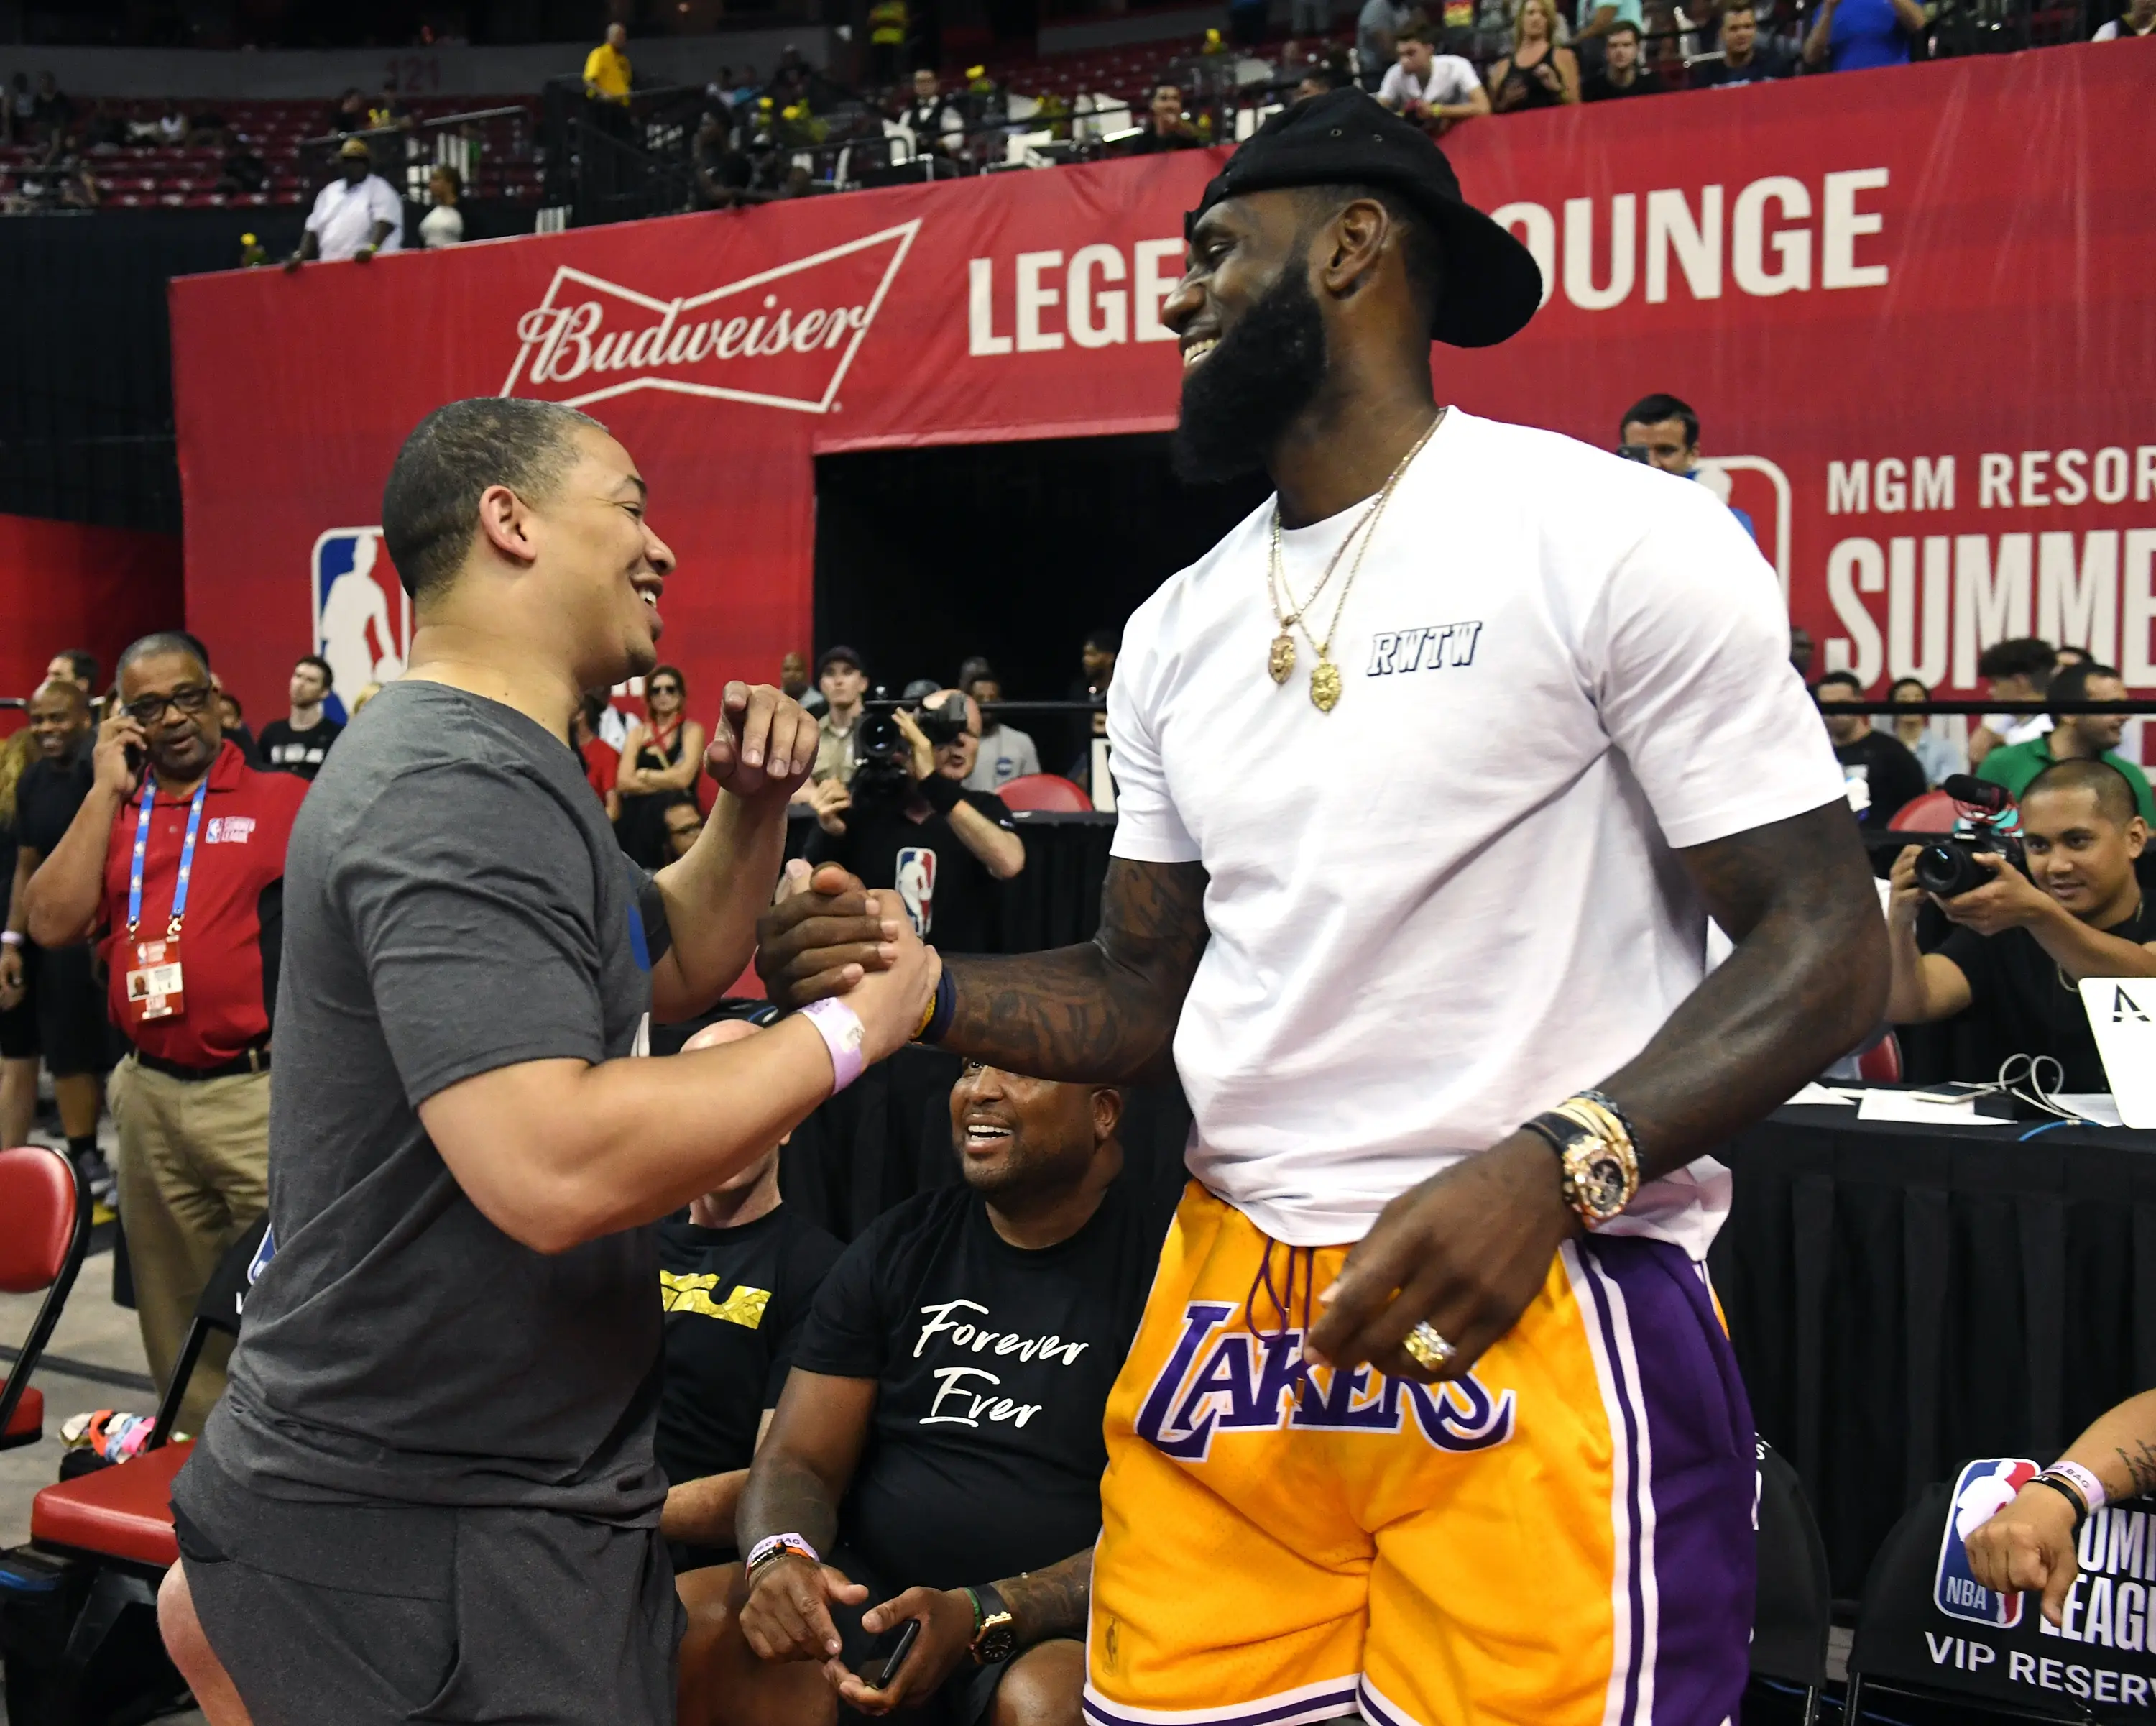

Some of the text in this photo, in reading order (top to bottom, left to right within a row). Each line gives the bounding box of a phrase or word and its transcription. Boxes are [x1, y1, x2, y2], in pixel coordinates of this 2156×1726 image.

[517, 293, 867, 384] Budweiser
[1826, 454, 1955, 515] MGM
[1824, 528, 2156, 690] SUMME
[1366, 620, 1483, 677] RWTW
[913, 1299, 1089, 1366] Forever
[919, 1367, 1042, 1428] Ever
[2065, 1468, 2091, 1489] BAG
[1946, 1576, 1986, 1611] NBA
[1925, 1630, 1996, 1672] VIP
